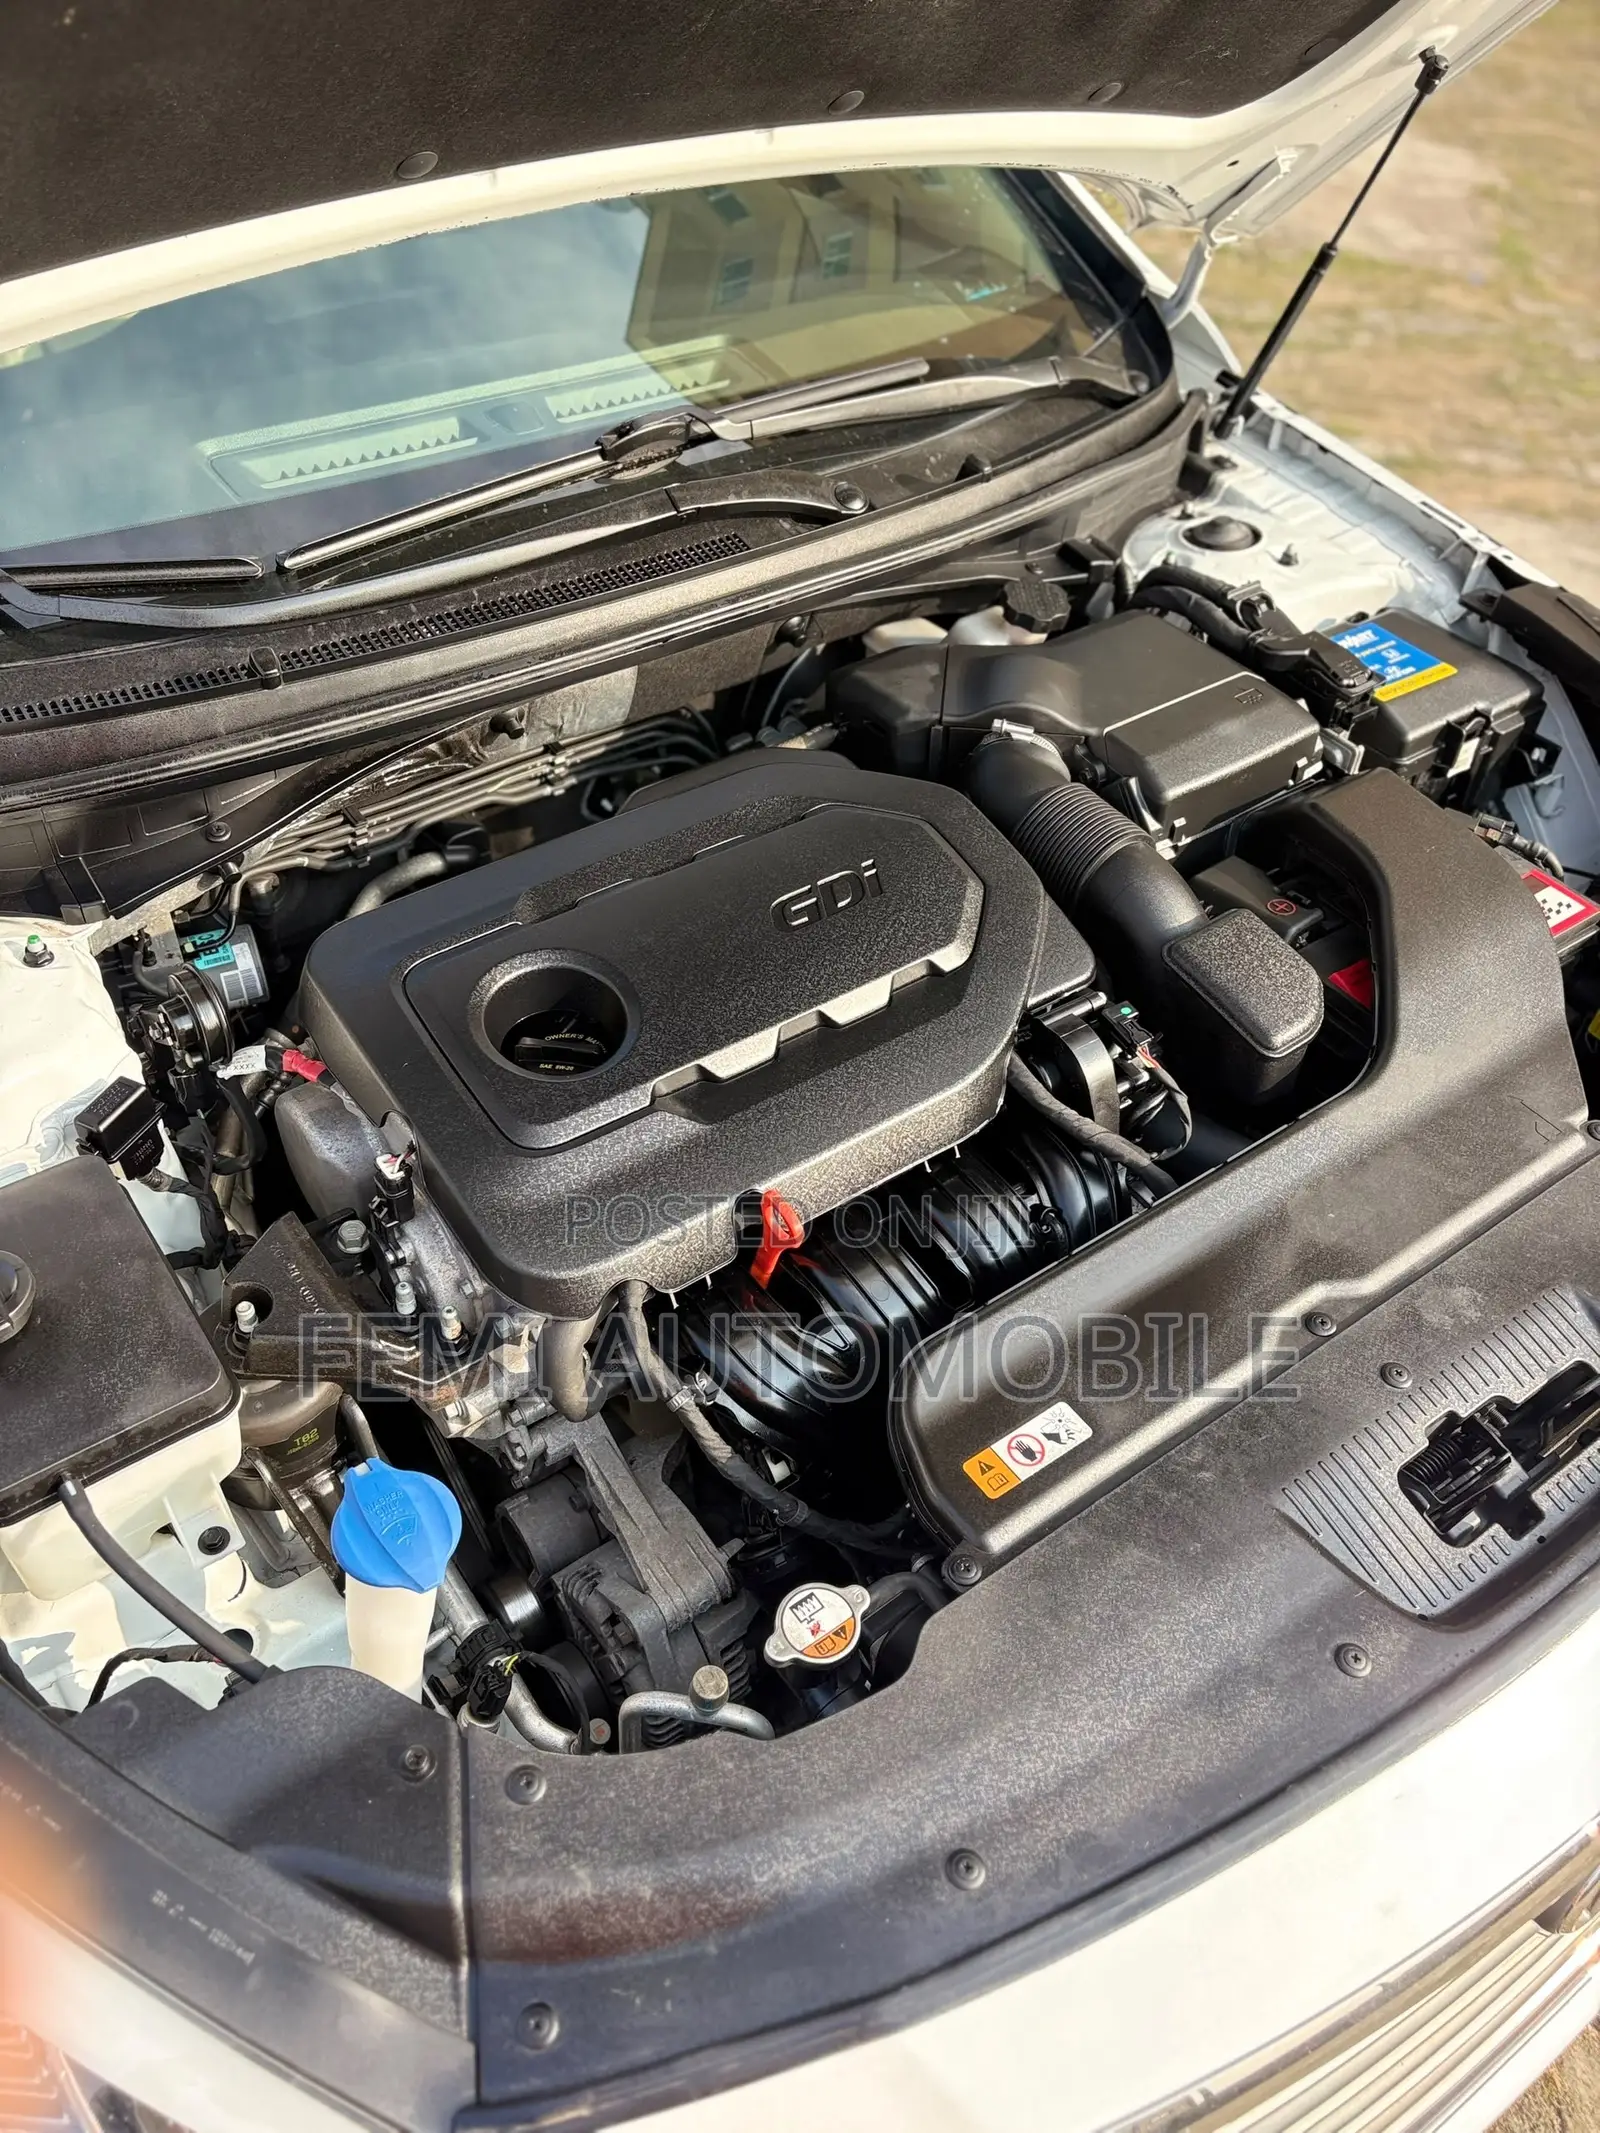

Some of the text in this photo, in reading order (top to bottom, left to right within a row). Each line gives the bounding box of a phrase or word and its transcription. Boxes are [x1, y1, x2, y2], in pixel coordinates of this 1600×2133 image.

[769, 859, 883, 933] GDi
[545, 1033, 585, 1042] OWNER'S
[364, 1489, 403, 1514] WASHER
